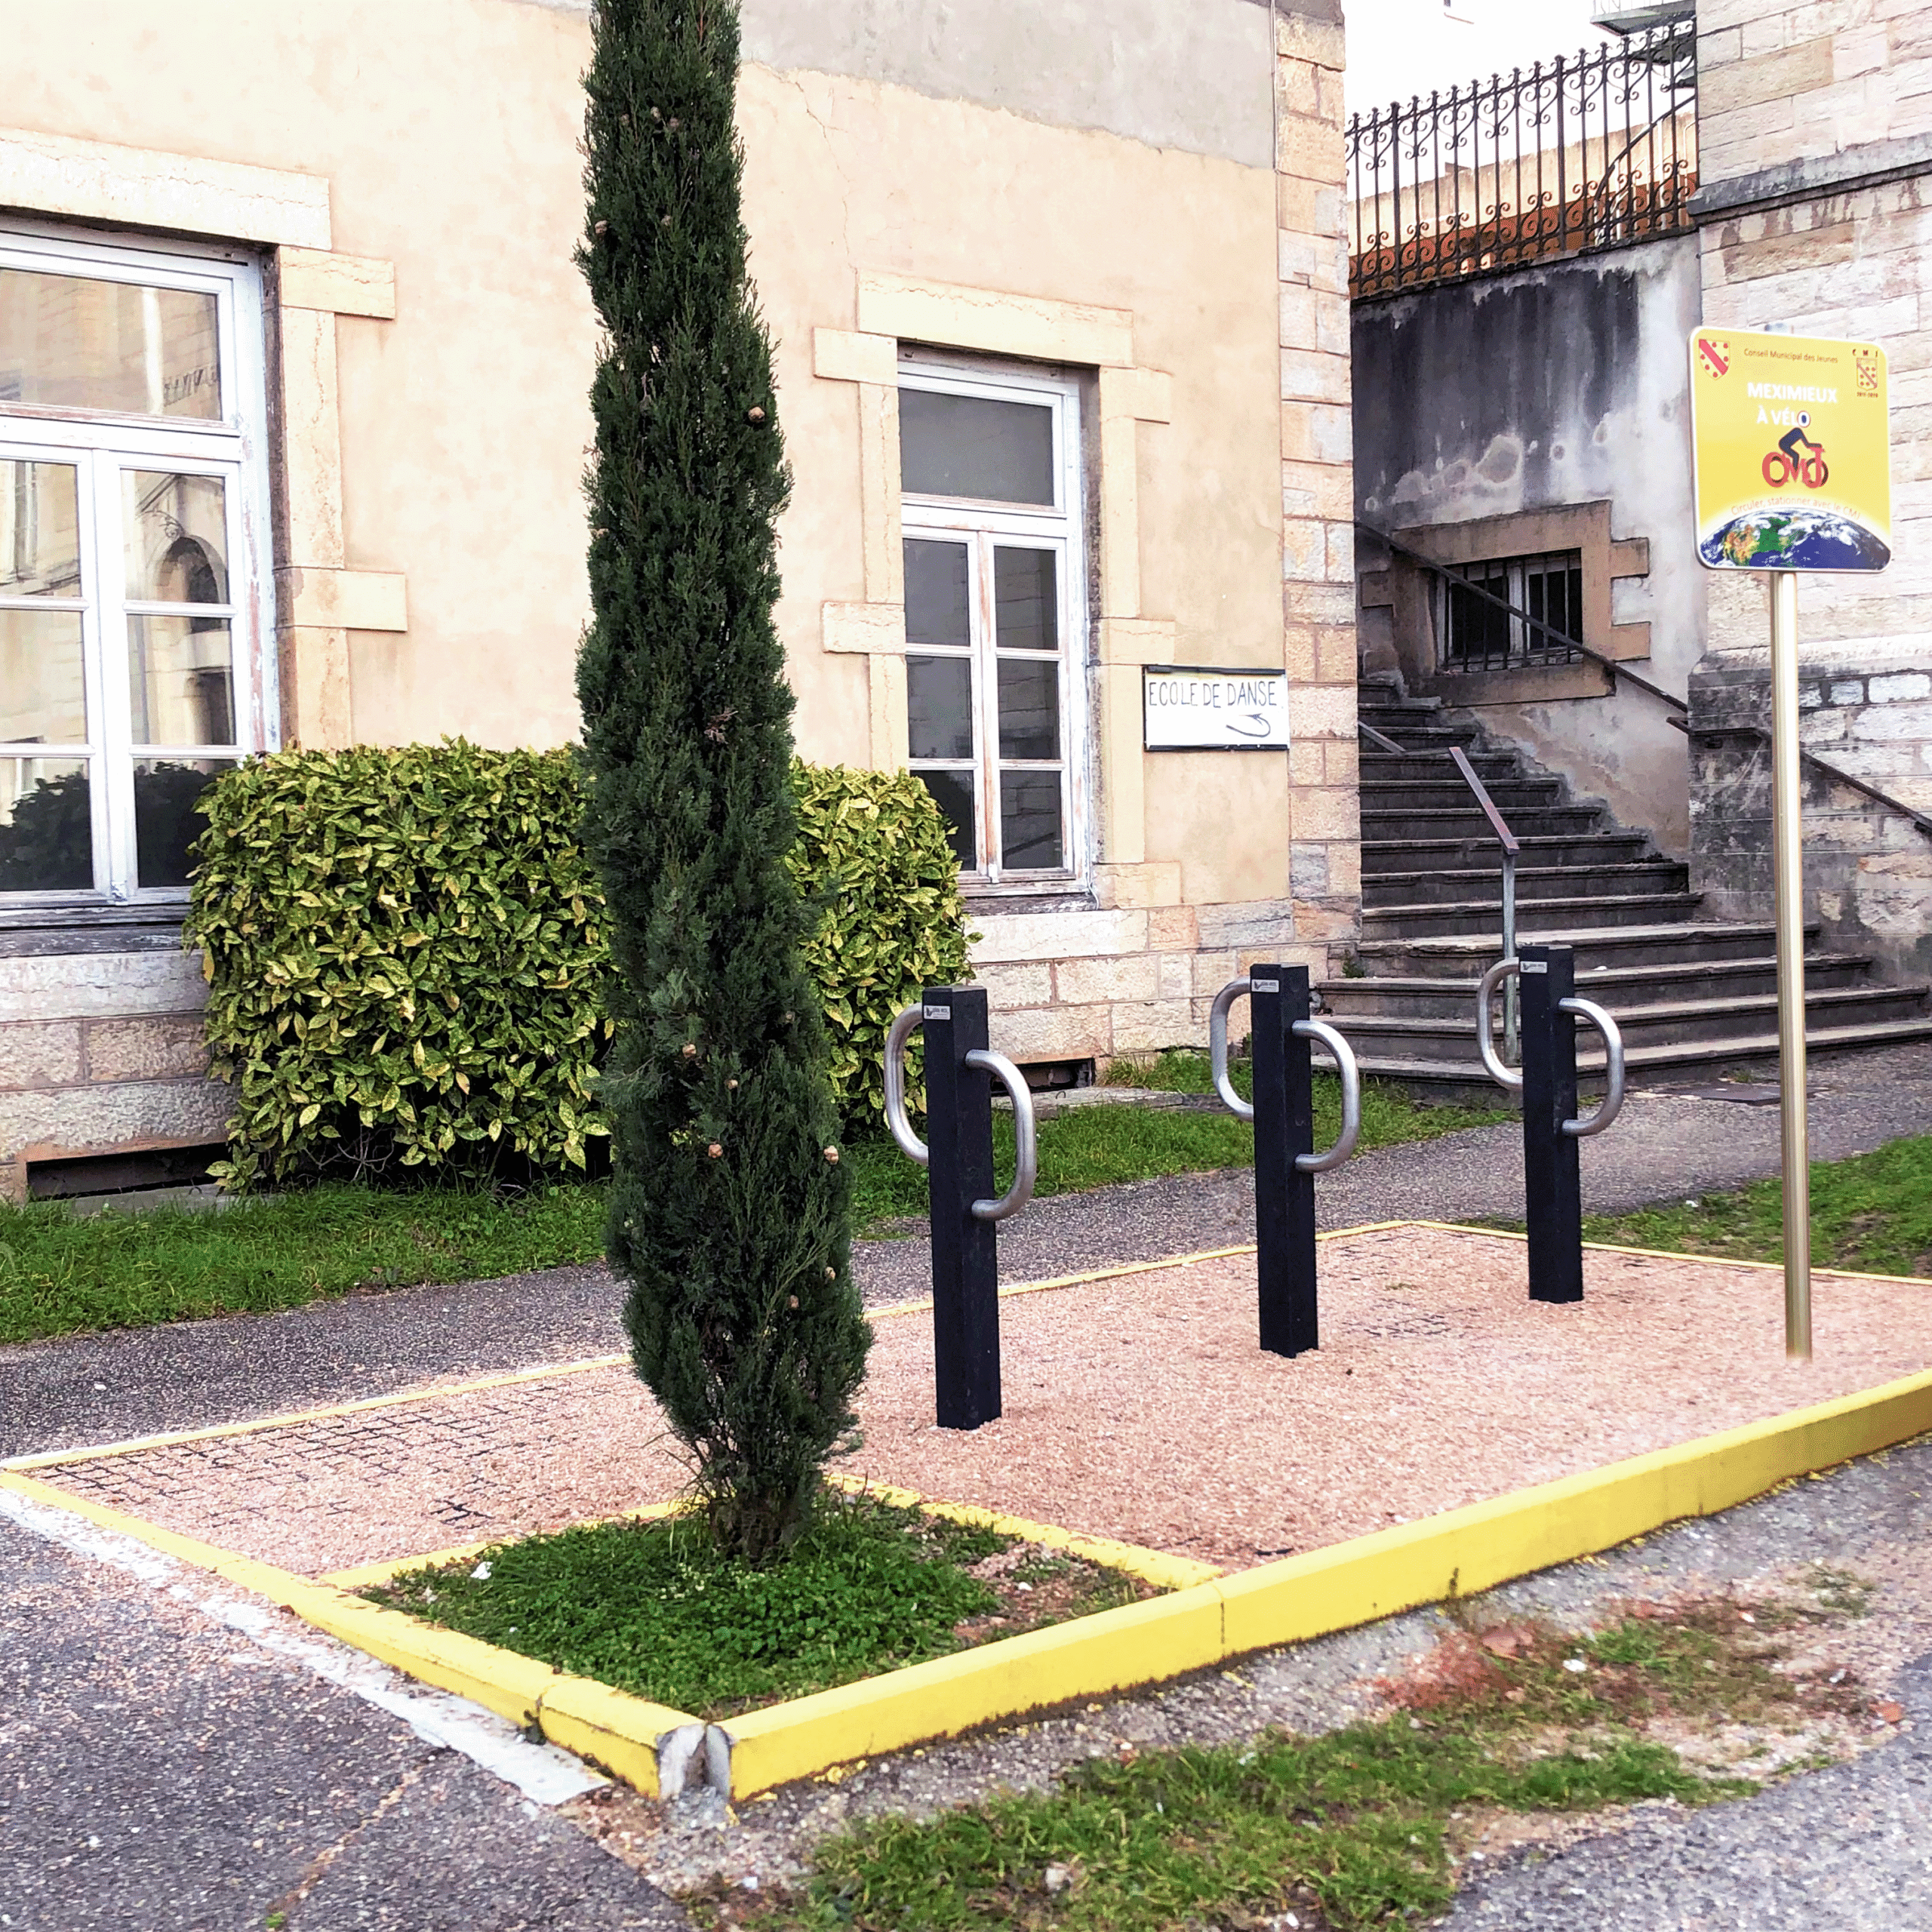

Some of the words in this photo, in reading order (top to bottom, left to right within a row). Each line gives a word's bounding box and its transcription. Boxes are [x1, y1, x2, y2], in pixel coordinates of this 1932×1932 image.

[1743, 348, 1769, 358] Conseil
[1770, 350, 1803, 361] Municipal
[1803, 353, 1815, 361] des
[1817, 355, 1838, 364] Jeunes
[1747, 382, 1838, 403] MEXIMIEUX
[1757, 405, 1768, 425] À
[1770, 407, 1811, 428] VÉLO
[1731, 500, 1765, 515] Circuler,
[1767, 496, 1810, 506] stationner
[1813, 499, 1832, 510] avec
[1833, 502, 1841, 511] le
[1149, 681, 1198, 706] ECOLE
[1203, 683, 1222, 709] DE
[1226, 681, 1278, 706] DANSE
